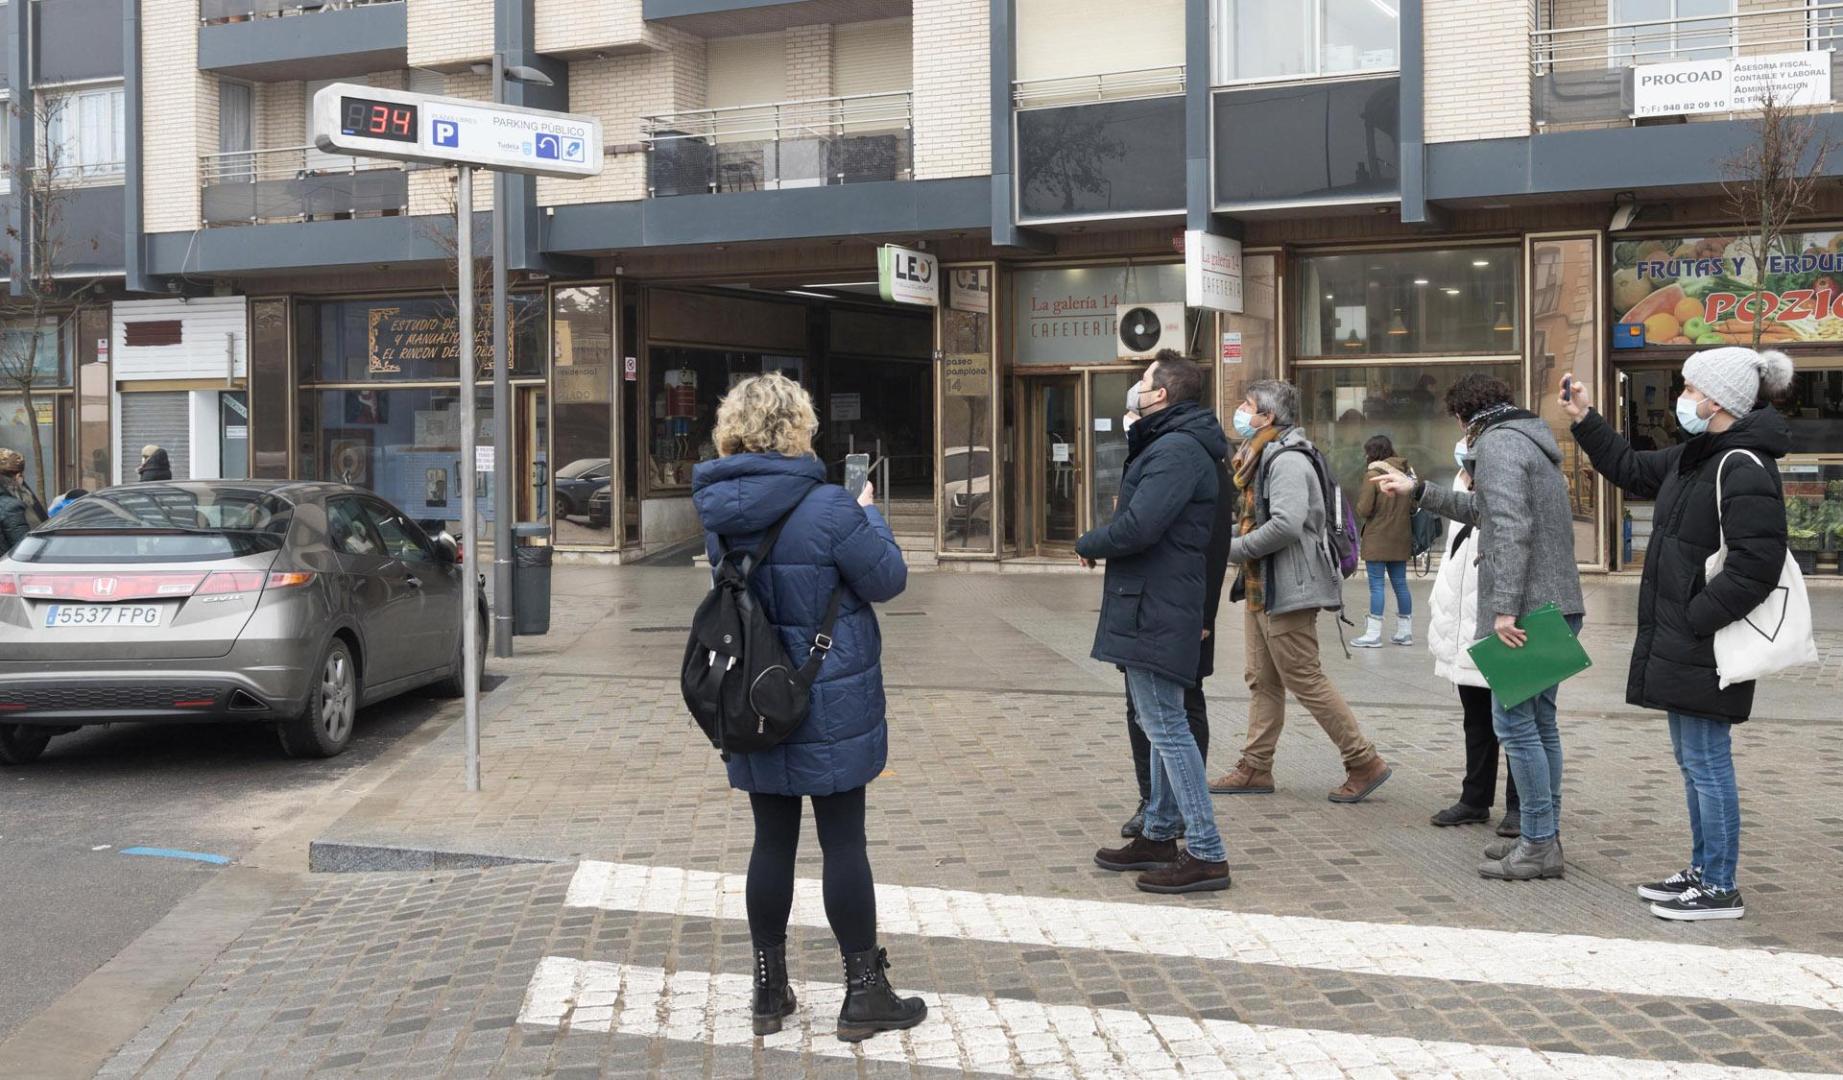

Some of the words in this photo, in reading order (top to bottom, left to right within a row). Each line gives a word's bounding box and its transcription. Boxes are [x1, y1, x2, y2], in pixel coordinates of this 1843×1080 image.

[1642, 70, 1723, 86] PROCOAD
[1734, 72, 1778, 82] CONTABLE
[1787, 69, 1826, 78] LABORAL
[1663, 103, 1681, 112] 948
[1698, 101, 1711, 109] 09
[1714, 100, 1725, 108] 10
[368, 105, 412, 136] 34
[493, 116, 539, 131] PARKING
[541, 122, 585, 137] PÚBLICO
[1201, 246, 1211, 263] La
[1232, 255, 1240, 271] 14
[1636, 257, 1724, 280] FRUTAS
[1731, 255, 1746, 277] Y
[1202, 275, 1241, 298] CAFETERÍA
[1031, 297, 1049, 312] La
[1053, 295, 1097, 315] galería
[1102, 293, 1119, 309] 14
[1704, 289, 1843, 325] POZI
[390, 318, 438, 331] ESTUDIO
[382, 347, 396, 360] EL
[946, 358, 973, 368] paseo
[946, 368, 987, 378] pamplona
[946, 378, 962, 393] 14
[60, 607, 113, 624] 5537
[117, 607, 157, 624] FPG
